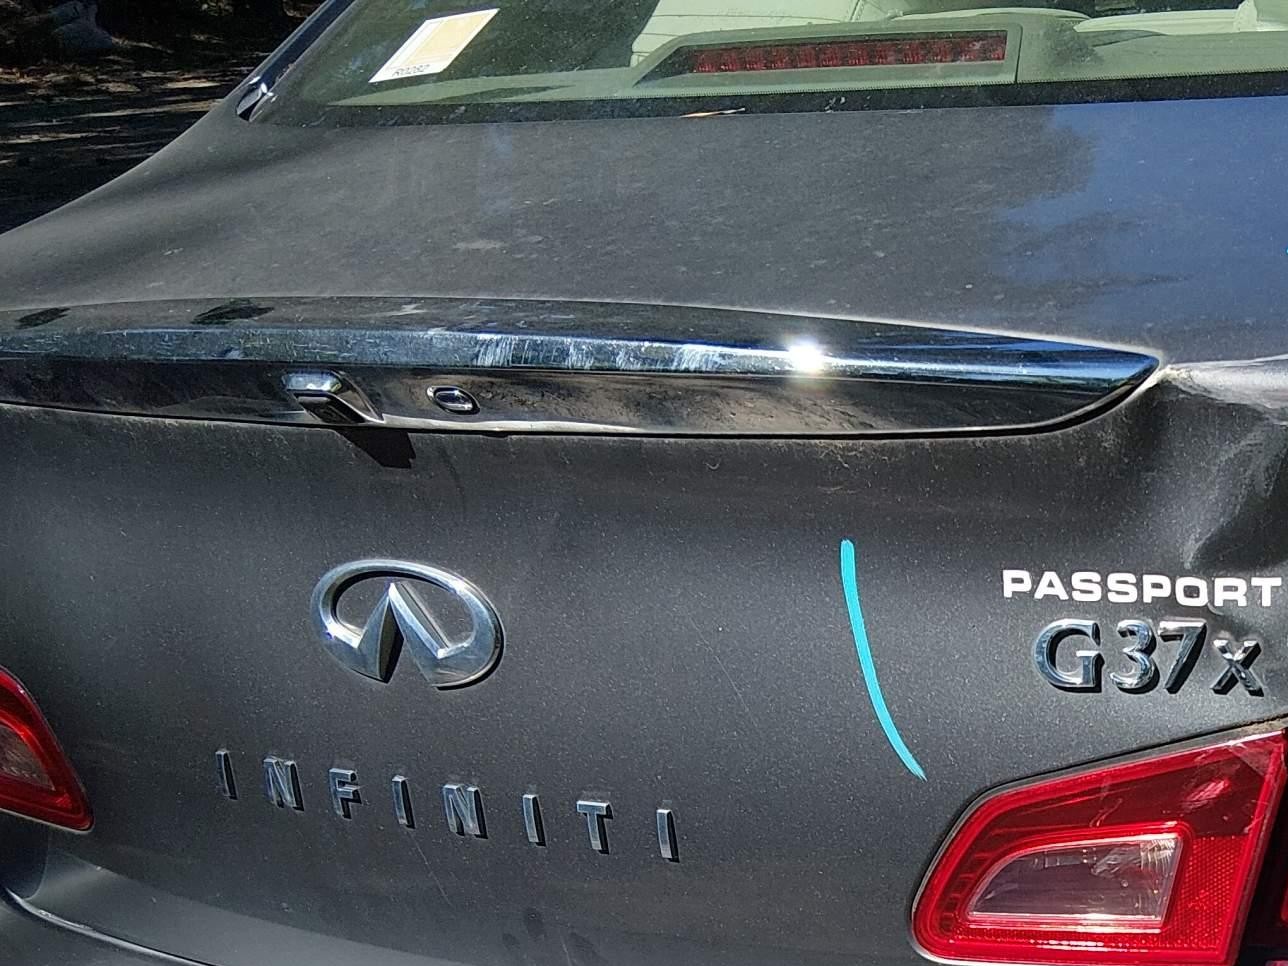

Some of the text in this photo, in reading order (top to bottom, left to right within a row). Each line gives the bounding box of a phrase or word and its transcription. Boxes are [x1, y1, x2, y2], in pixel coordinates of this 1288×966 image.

[1002, 569, 1282, 607] PASSPORT
[1033, 618, 1264, 697] G37x
[215, 748, 679, 861] INFINITI
